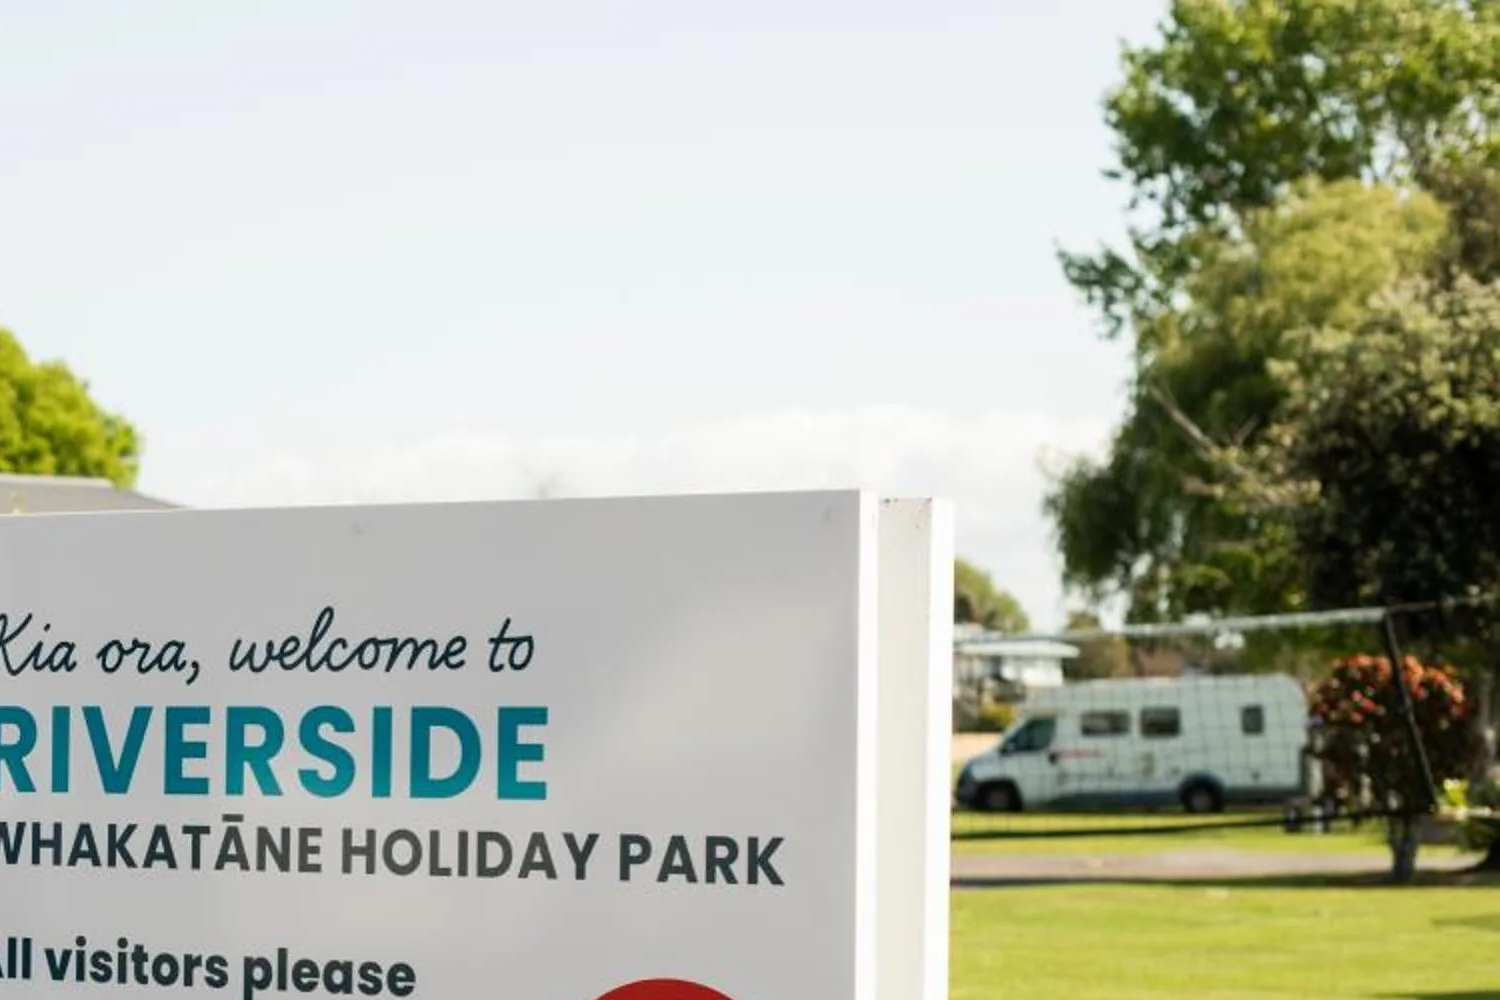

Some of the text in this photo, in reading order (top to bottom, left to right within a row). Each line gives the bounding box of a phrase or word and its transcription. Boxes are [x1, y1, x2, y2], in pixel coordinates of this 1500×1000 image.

[95, 637, 200, 686] ora,
[228, 605, 468, 674] welcome
[487, 617, 535, 673] to
[341, 827, 600, 881] HOLIDAY
[619, 833, 785, 886] PARK
[44, 935, 229, 989] visitors
